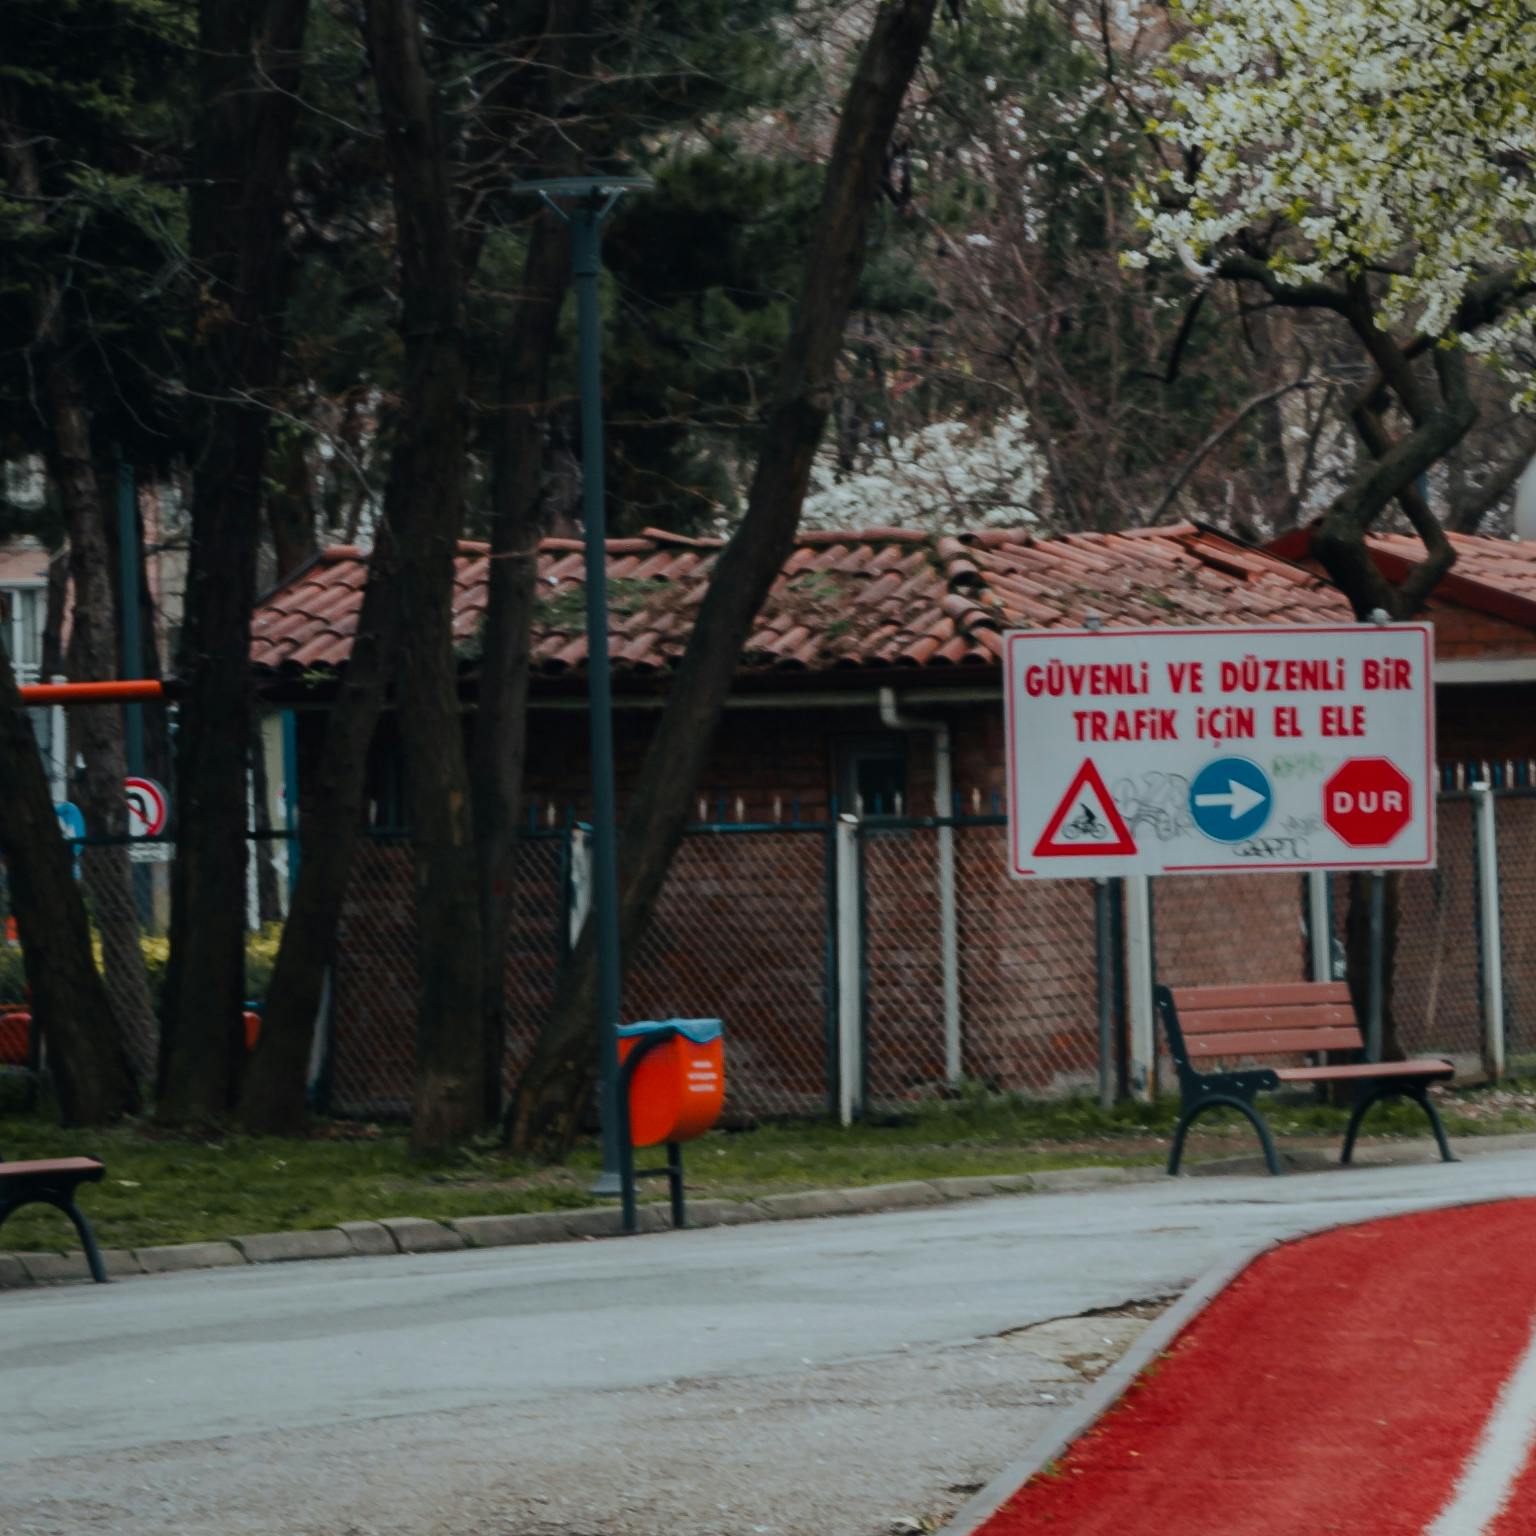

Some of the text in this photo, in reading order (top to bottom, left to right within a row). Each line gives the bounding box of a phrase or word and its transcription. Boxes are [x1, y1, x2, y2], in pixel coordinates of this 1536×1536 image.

[1167, 662, 1203, 694] VE
[1273, 706, 1303, 737] EL
[1319, 705, 1365, 737] ELE
[1332, 790, 1403, 814] DUR
